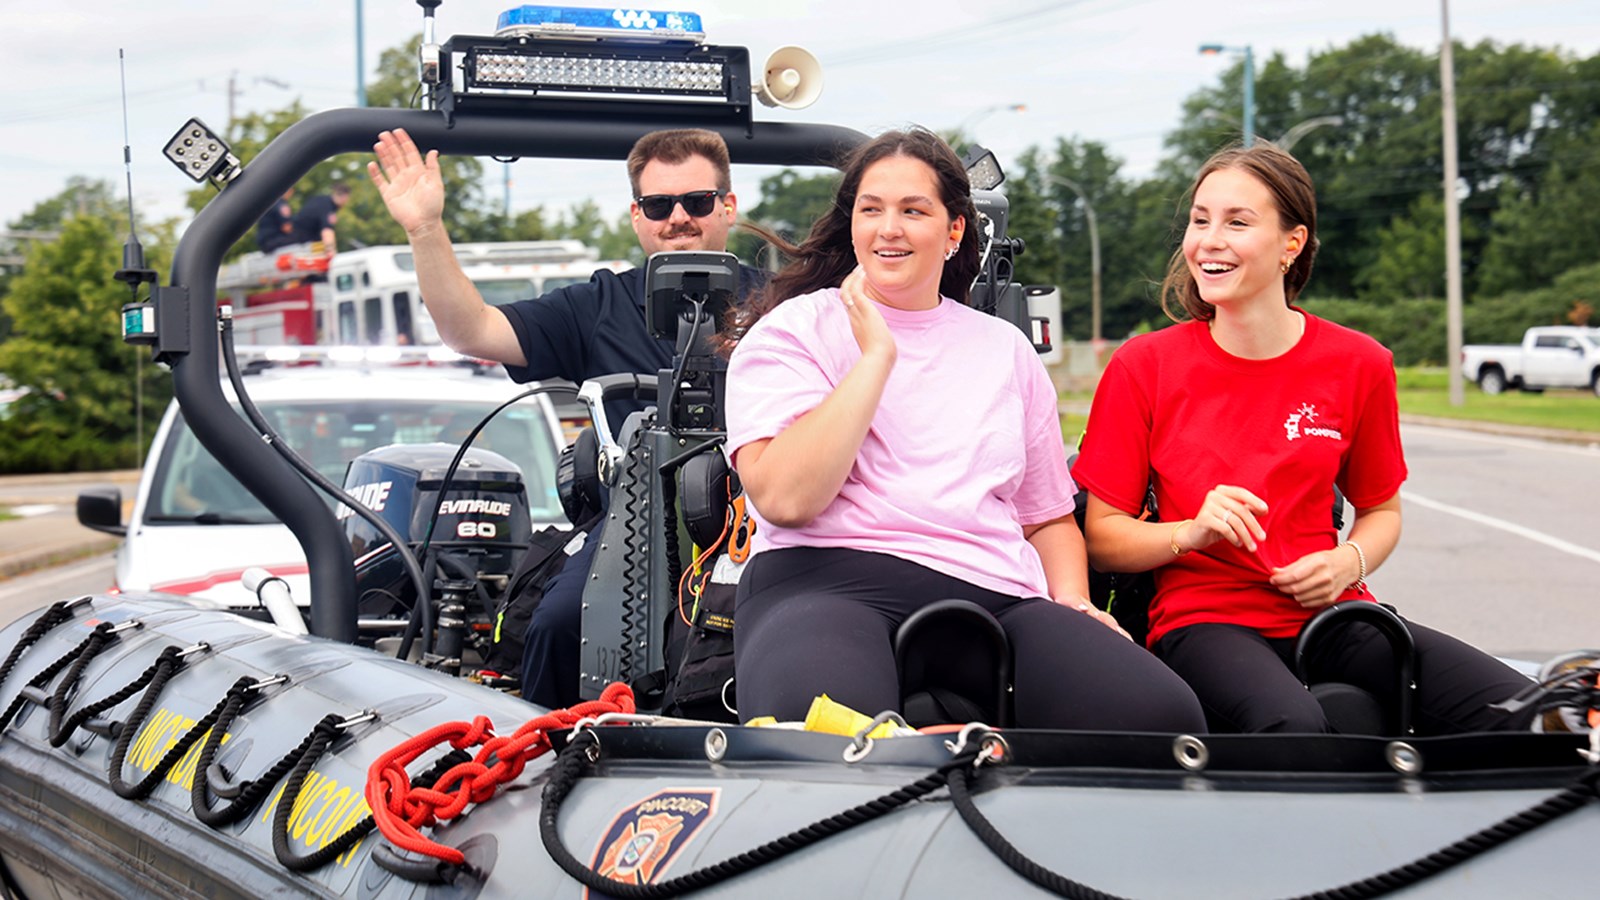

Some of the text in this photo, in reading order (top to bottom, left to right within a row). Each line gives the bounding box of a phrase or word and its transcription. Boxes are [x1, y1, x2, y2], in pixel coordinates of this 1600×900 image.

[438, 500, 511, 516] EVINRUDE
[457, 521, 496, 538] 60
[636, 797, 708, 816] PINCOURT
